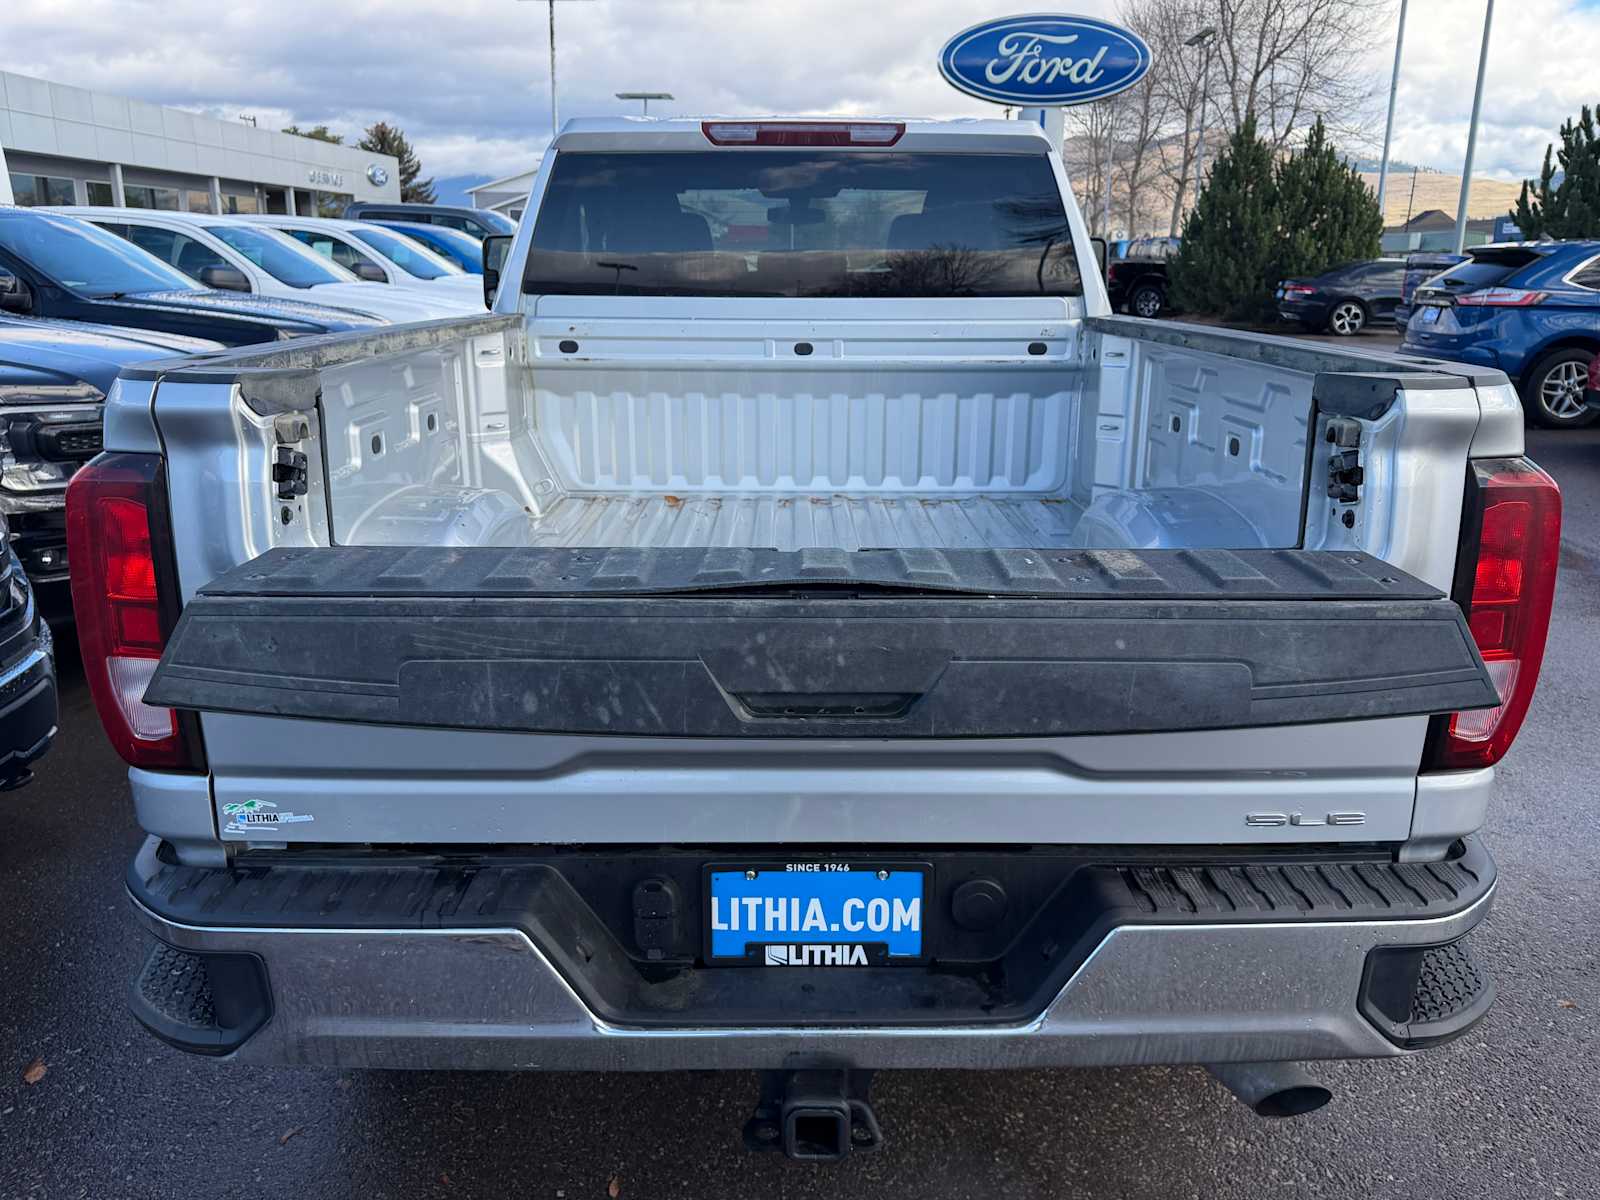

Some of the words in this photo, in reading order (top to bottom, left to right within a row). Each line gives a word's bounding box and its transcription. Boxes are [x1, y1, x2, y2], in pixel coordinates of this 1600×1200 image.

[985, 32, 1108, 84] Ford
[247, 814, 280, 823] LITHIA
[1246, 811, 1366, 827] SLE
[786, 863, 820, 872] SINCE
[824, 863, 850, 872] 1946
[711, 897, 921, 932] LITHIA.COM
[789, 945, 869, 966] LITHIA
